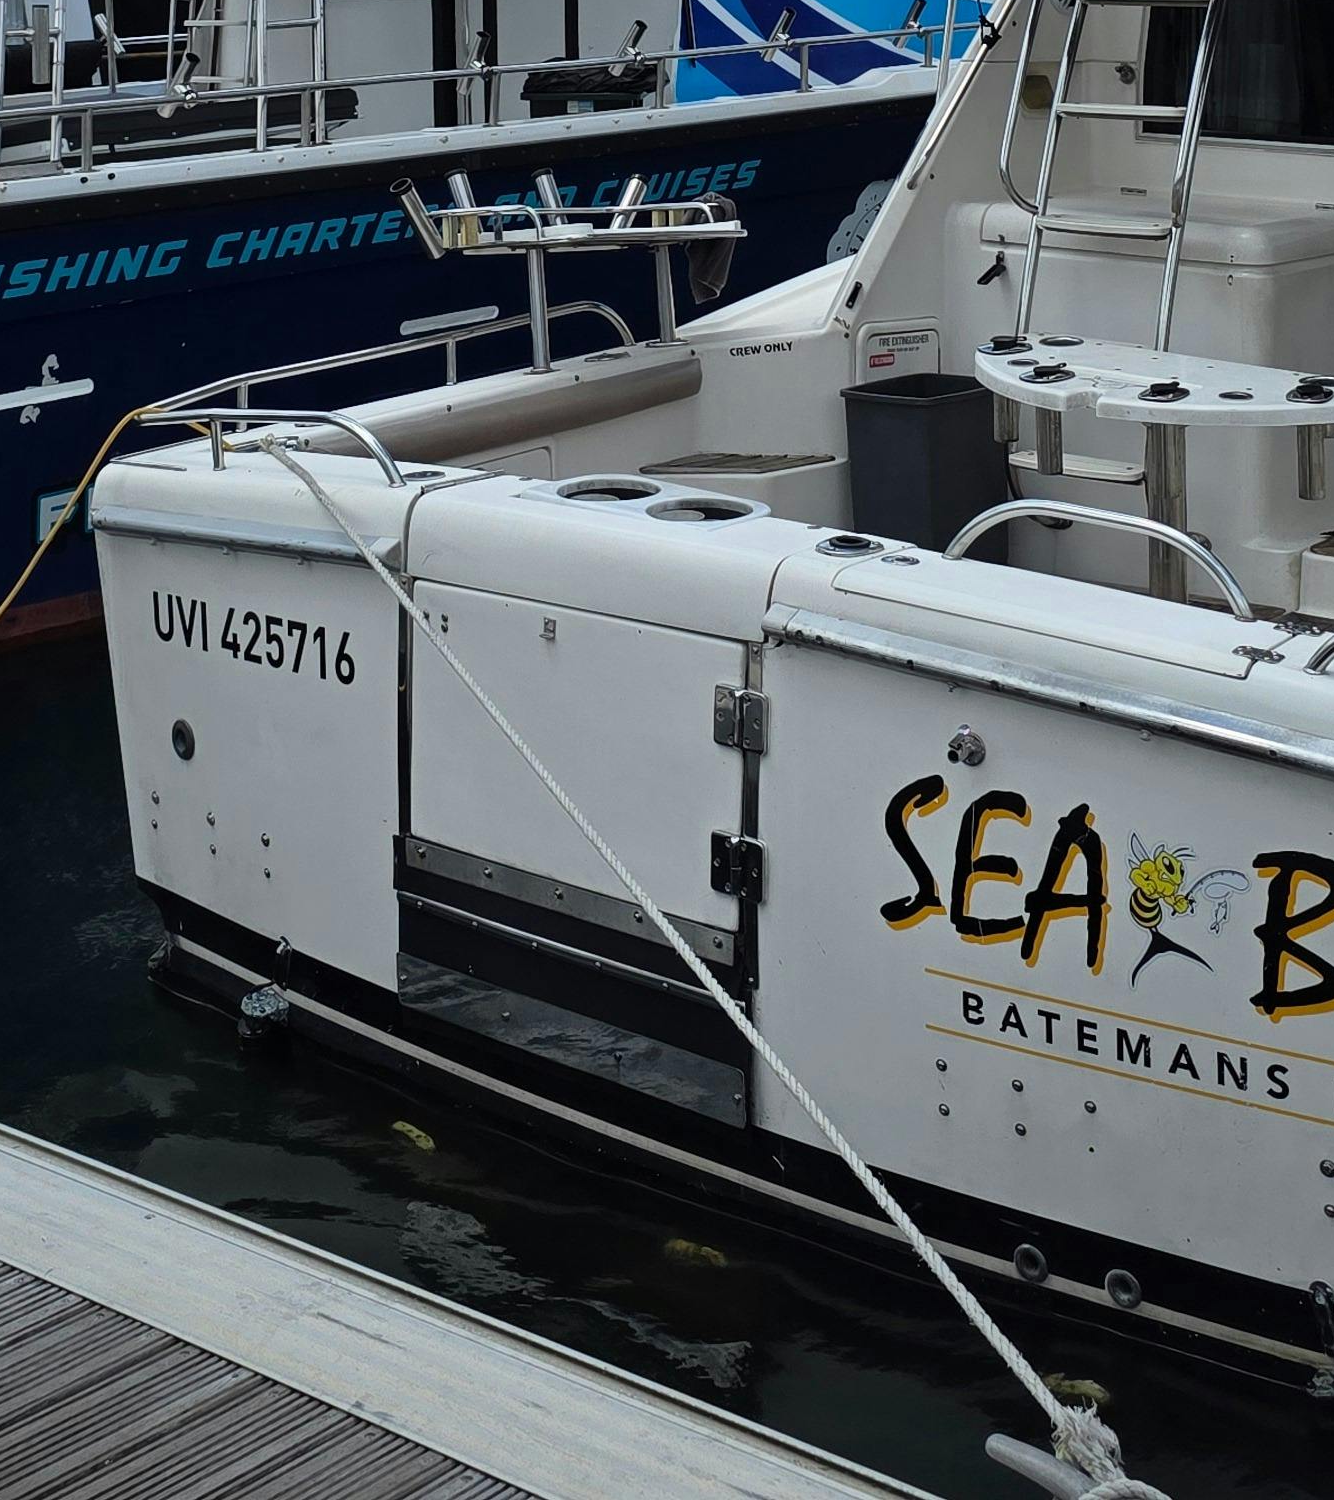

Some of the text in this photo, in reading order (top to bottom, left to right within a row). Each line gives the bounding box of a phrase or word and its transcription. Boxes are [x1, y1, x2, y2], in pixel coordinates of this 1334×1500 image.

[206, 202, 457, 269] CHARTE
[592, 159, 762, 207] CUISES
[729, 341, 793, 357] CREW ONLY
[220, 607, 356, 685] 425716
[880, 774, 1112, 976] SEA
[961, 990, 1290, 1100] BATEMANS
